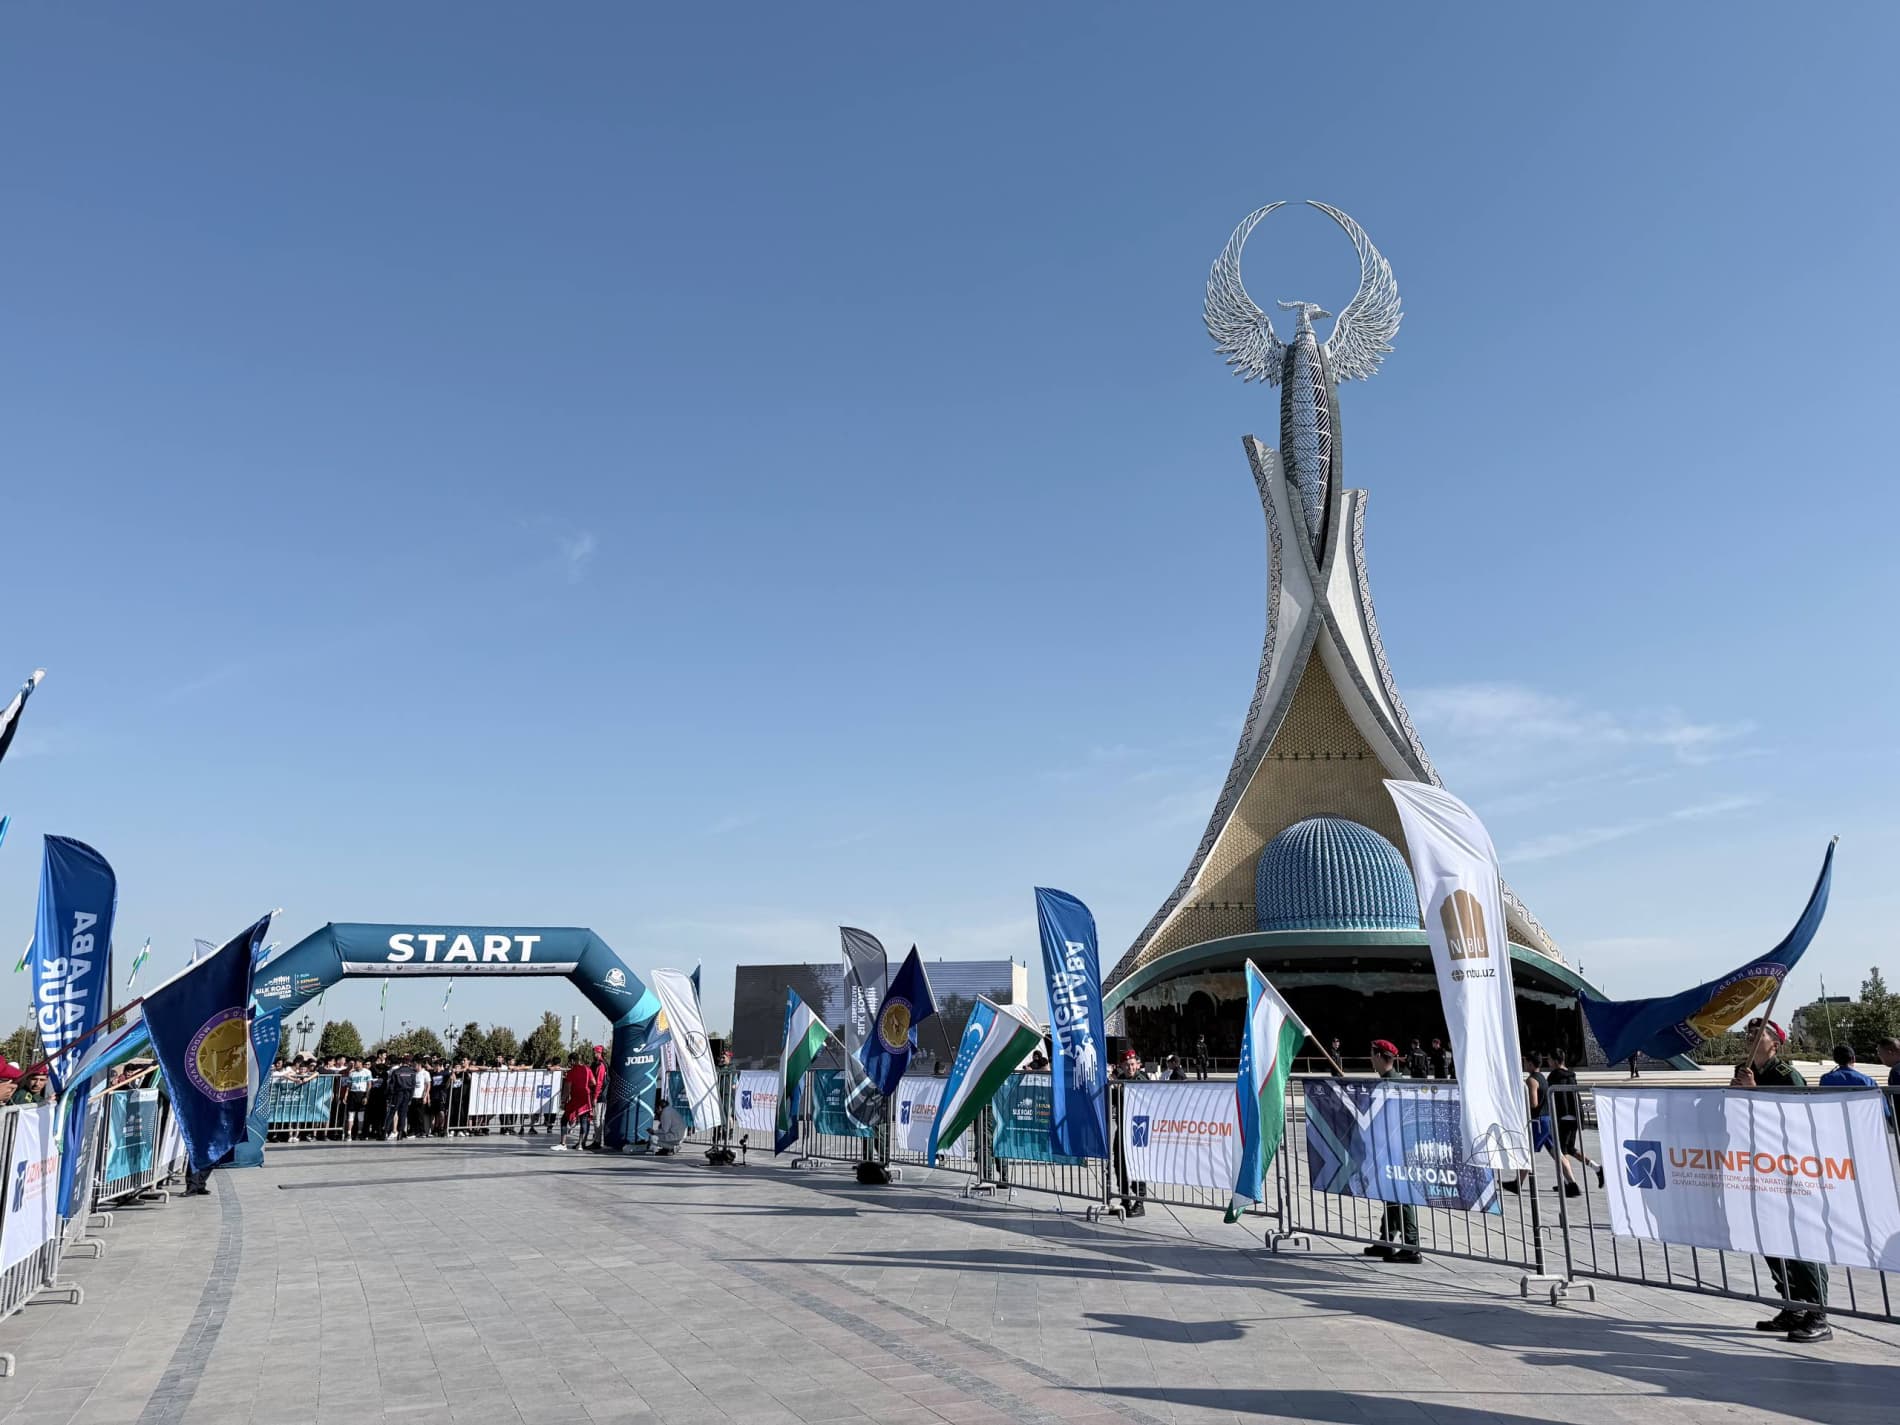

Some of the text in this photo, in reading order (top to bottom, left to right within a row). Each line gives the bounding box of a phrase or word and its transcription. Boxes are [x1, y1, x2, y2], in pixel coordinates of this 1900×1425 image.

[387, 933, 541, 962] START
[1450, 937, 1486, 954] NBU
[1466, 968, 1496, 978] nbu.uz
[270, 984, 291, 993] ROAD
[911, 1103, 939, 1116] UZINFO
[1151, 1119, 1232, 1137] UZINFOCOM
[1669, 1147, 1856, 1181] UZINFOCOM
[1385, 1164, 1457, 1185] SILK ROAD
[1429, 1185, 1460, 1198] KHIVA
